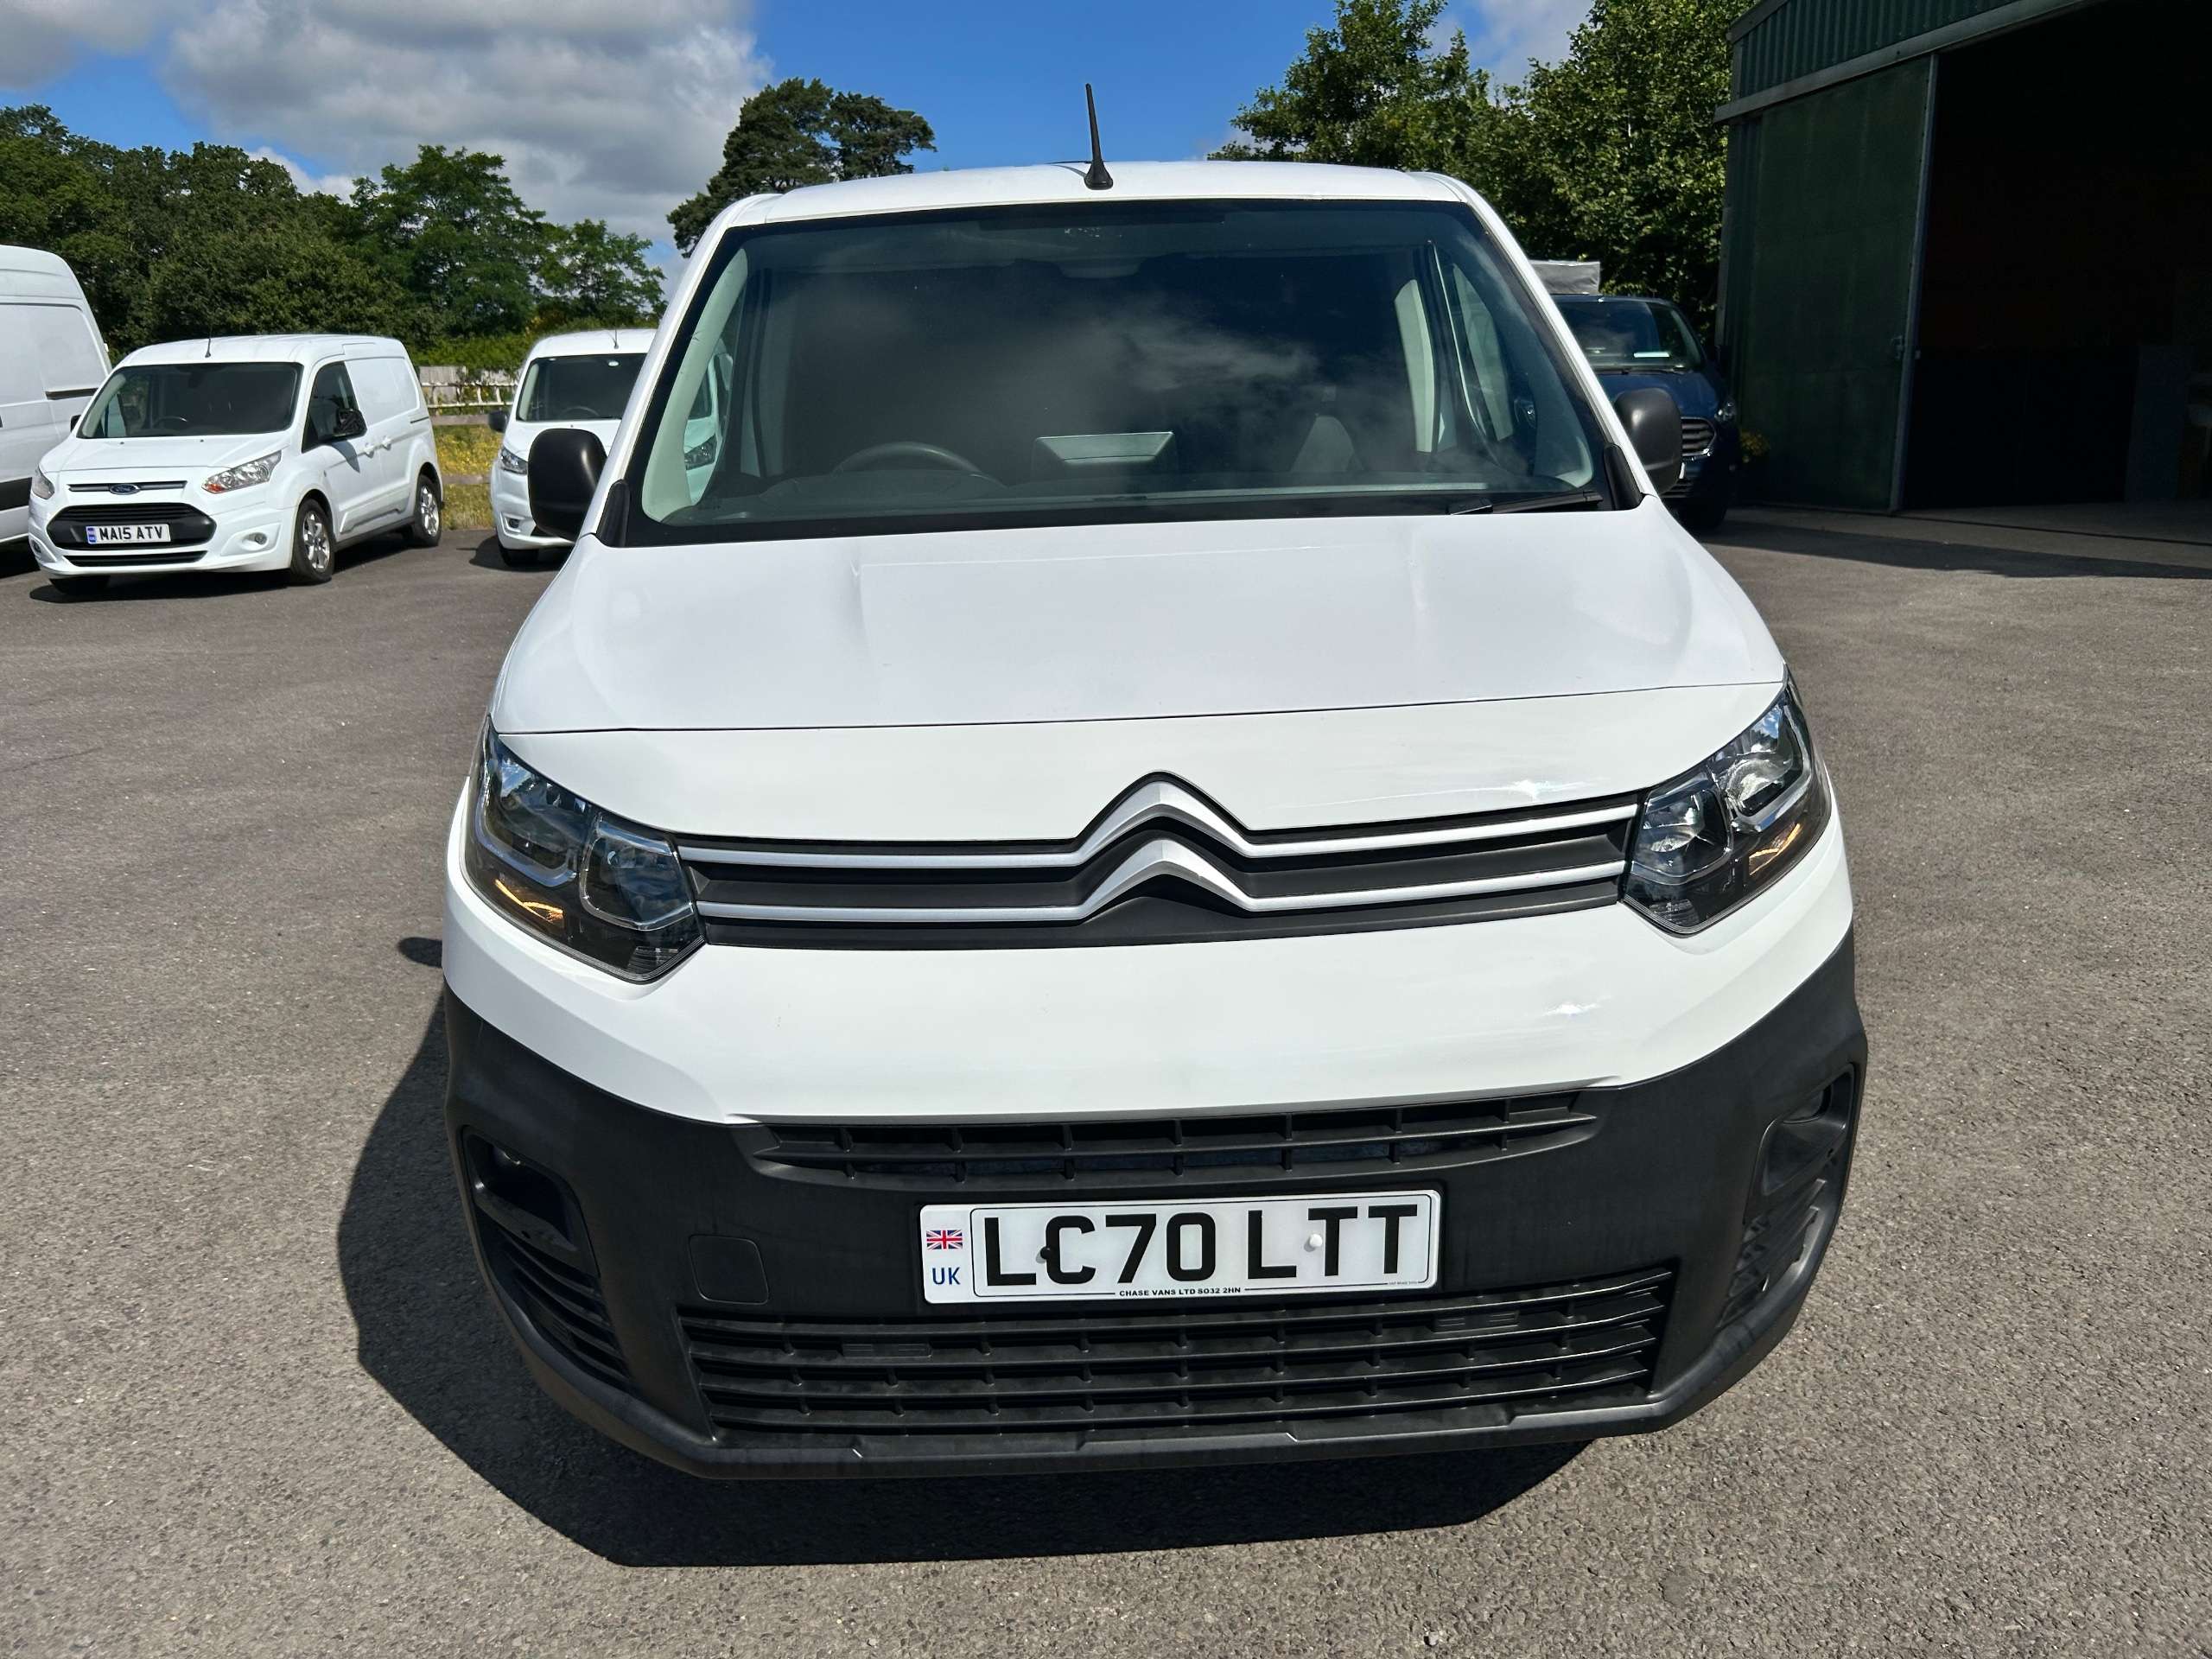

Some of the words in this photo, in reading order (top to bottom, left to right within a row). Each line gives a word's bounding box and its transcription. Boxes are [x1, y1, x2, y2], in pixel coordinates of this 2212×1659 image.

[99, 527, 132, 540] MA15
[137, 525, 162, 539] ATV
[983, 1212, 1217, 1287] LC70
[1247, 1204, 1418, 1279] LTT
[931, 1267, 961, 1286] UK
